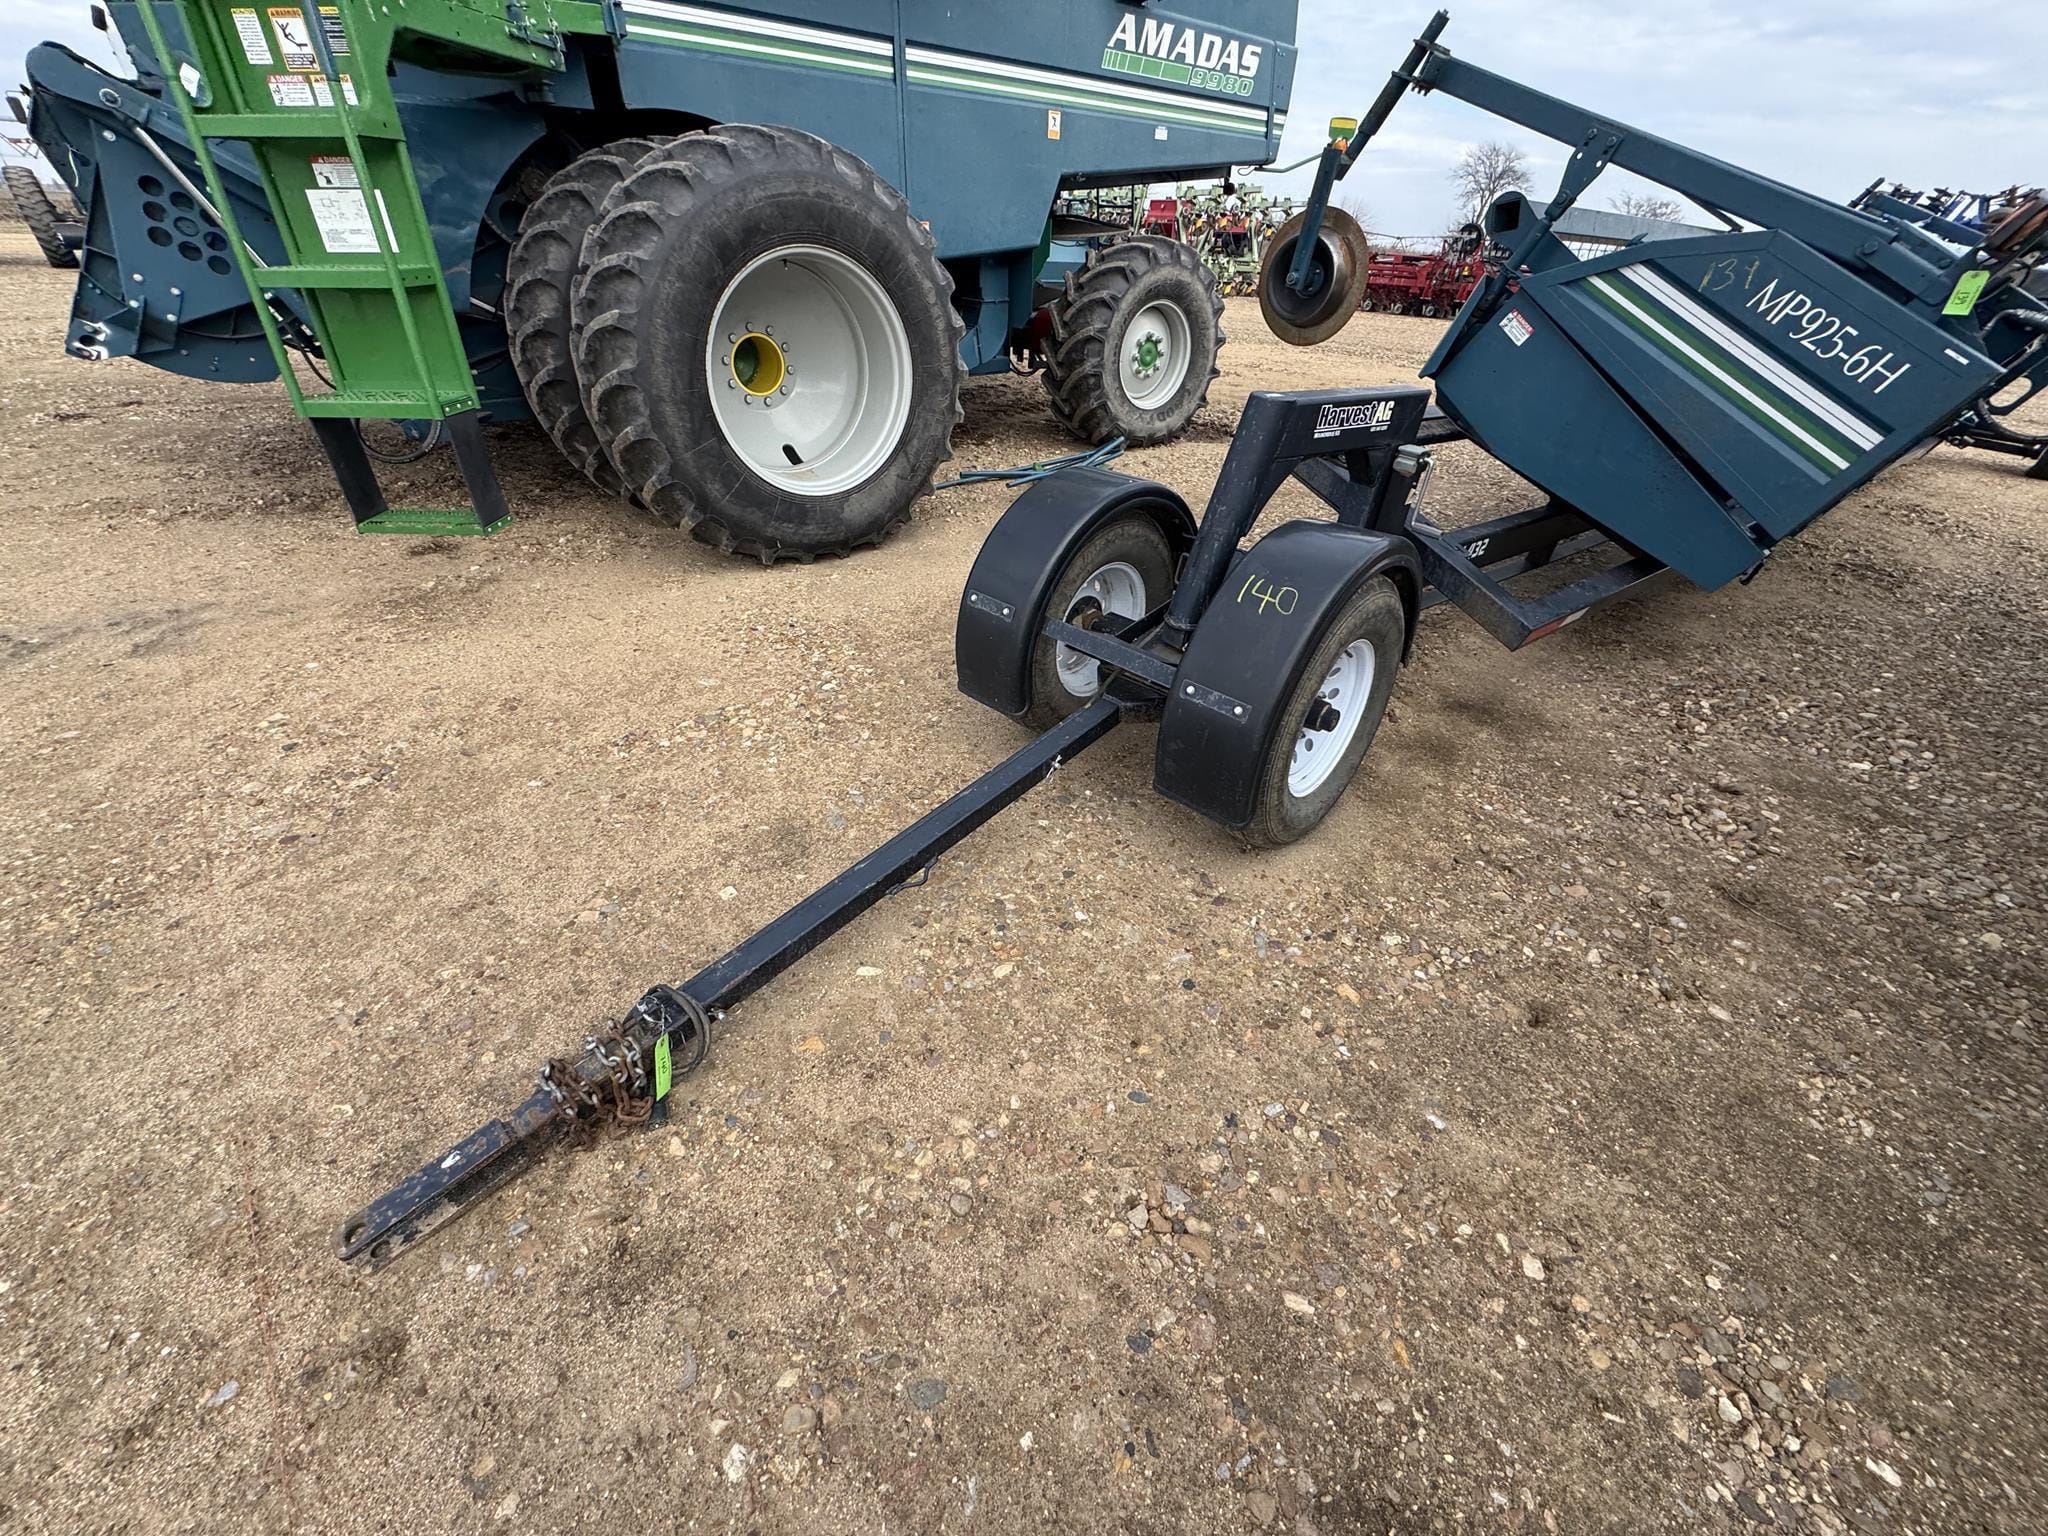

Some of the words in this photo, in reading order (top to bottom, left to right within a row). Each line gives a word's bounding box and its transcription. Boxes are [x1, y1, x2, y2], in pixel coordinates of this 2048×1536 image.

[1107, 12, 1263, 78] AMADAS
[1189, 68, 1255, 97] 9980
[1745, 278, 1912, 395] MP925-6H
[1236, 573, 1299, 616] 140
